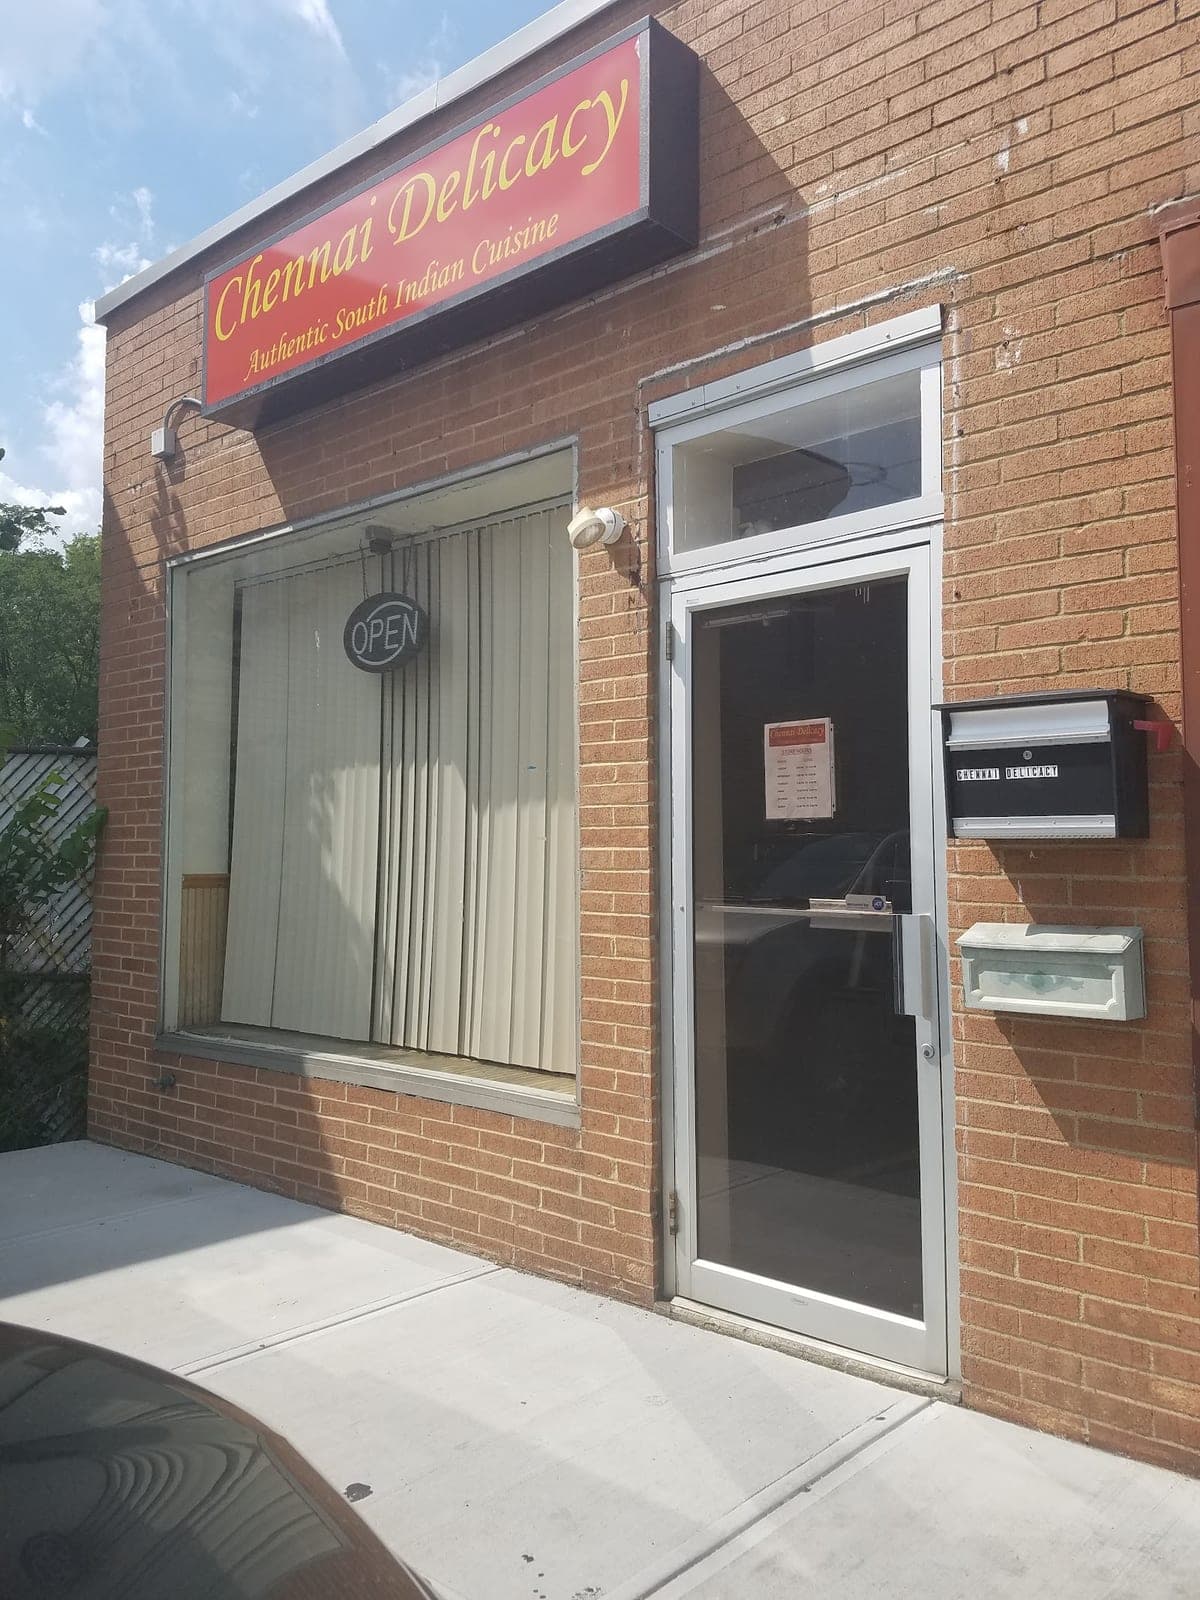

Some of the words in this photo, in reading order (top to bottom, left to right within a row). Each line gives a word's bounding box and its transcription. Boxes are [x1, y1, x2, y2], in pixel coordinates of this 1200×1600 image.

[214, 197, 376, 342] Chennai
[388, 79, 629, 246] Delicacy
[244, 320, 328, 381] Authentic
[331, 284, 388, 340] South
[393, 259, 465, 309] Indian
[473, 213, 559, 274] Cuisine
[352, 610, 418, 654] OPEN
[957, 768, 999, 780] CHENNAI
[1006, 766, 1058, 779] DELICACY
